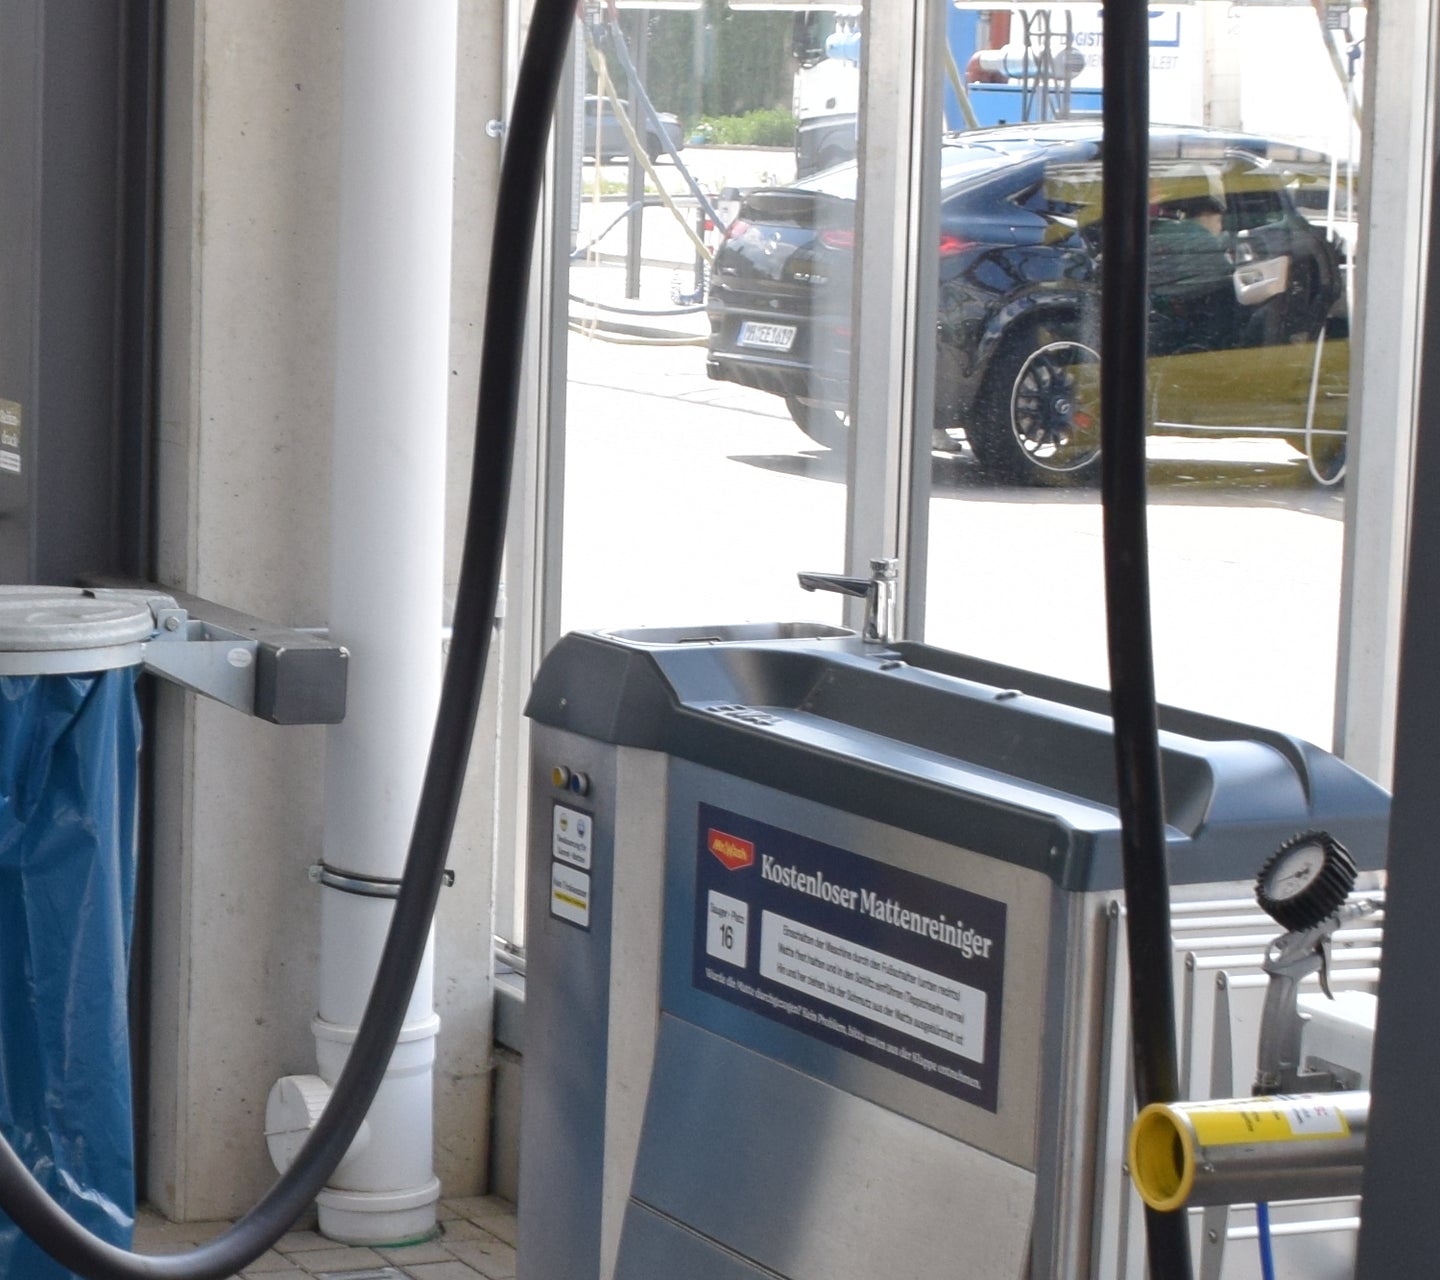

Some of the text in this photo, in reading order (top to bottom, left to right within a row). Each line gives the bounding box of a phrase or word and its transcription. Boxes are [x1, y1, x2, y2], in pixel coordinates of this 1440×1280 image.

[720, 923, 734, 950] 16
[761, 853, 993, 959] Kostenloser Mattenreiniger
